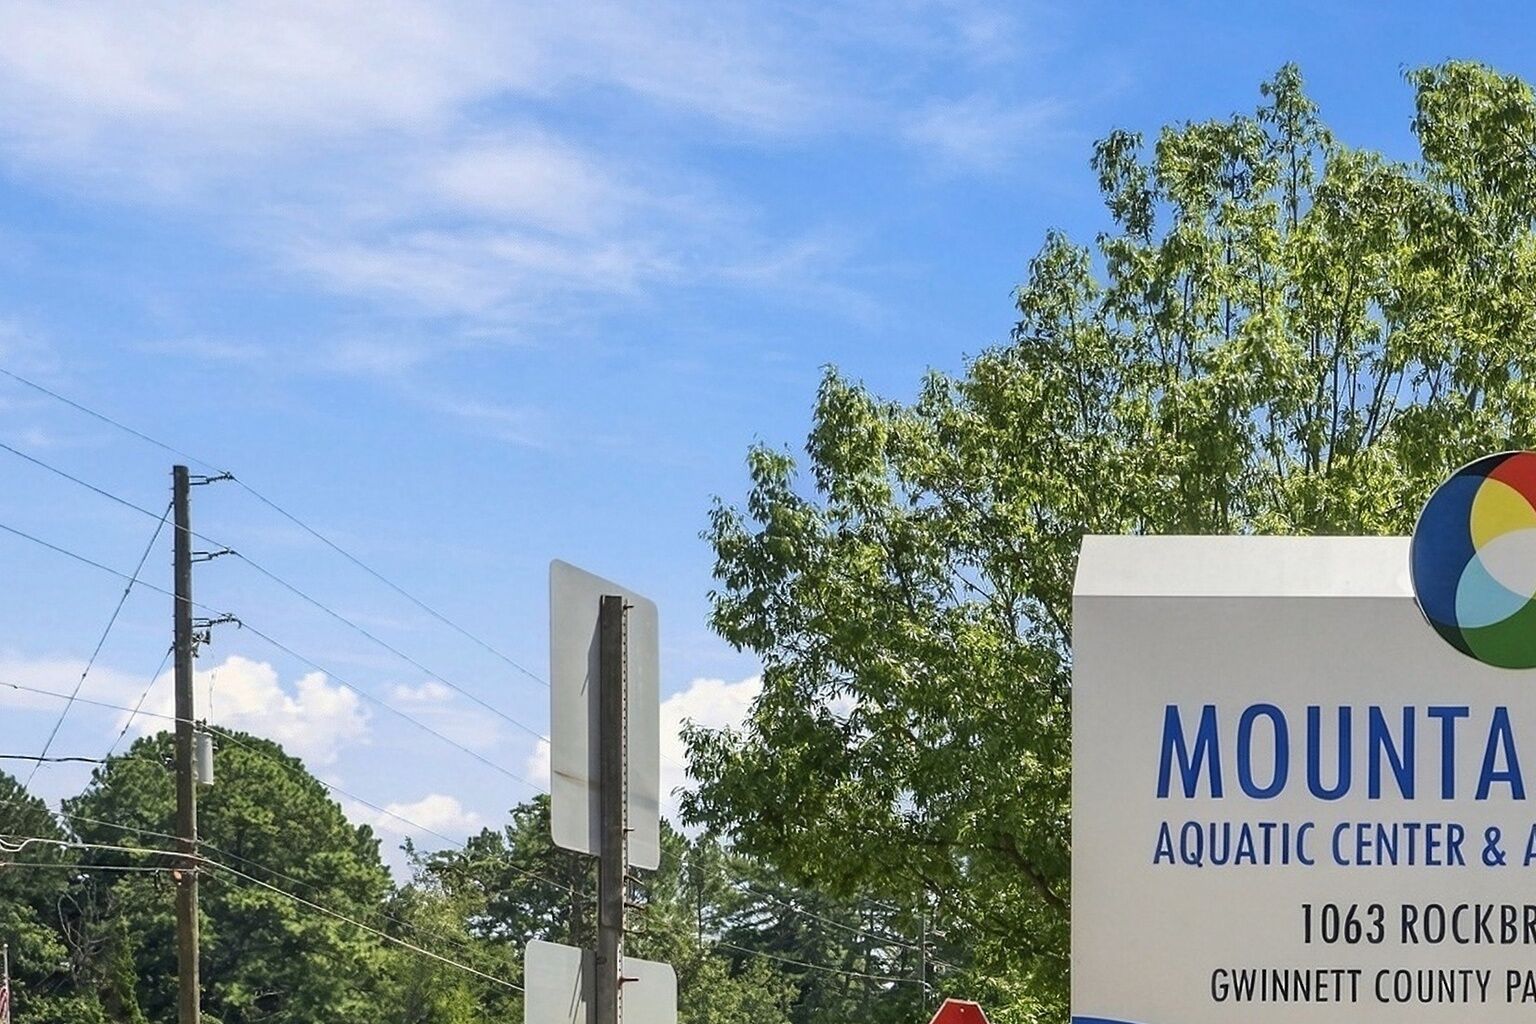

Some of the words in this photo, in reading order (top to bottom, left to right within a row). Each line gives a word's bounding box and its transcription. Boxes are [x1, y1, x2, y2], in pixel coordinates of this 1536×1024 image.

[1152, 820, 1315, 868] AQUATIC
[1331, 822, 1466, 867] CENTER
[1481, 825, 1507, 867] &
[1301, 903, 1385, 945] 1063
[1211, 968, 1362, 1003] GWINNETT
[1375, 969, 1492, 1004] COUNTY
